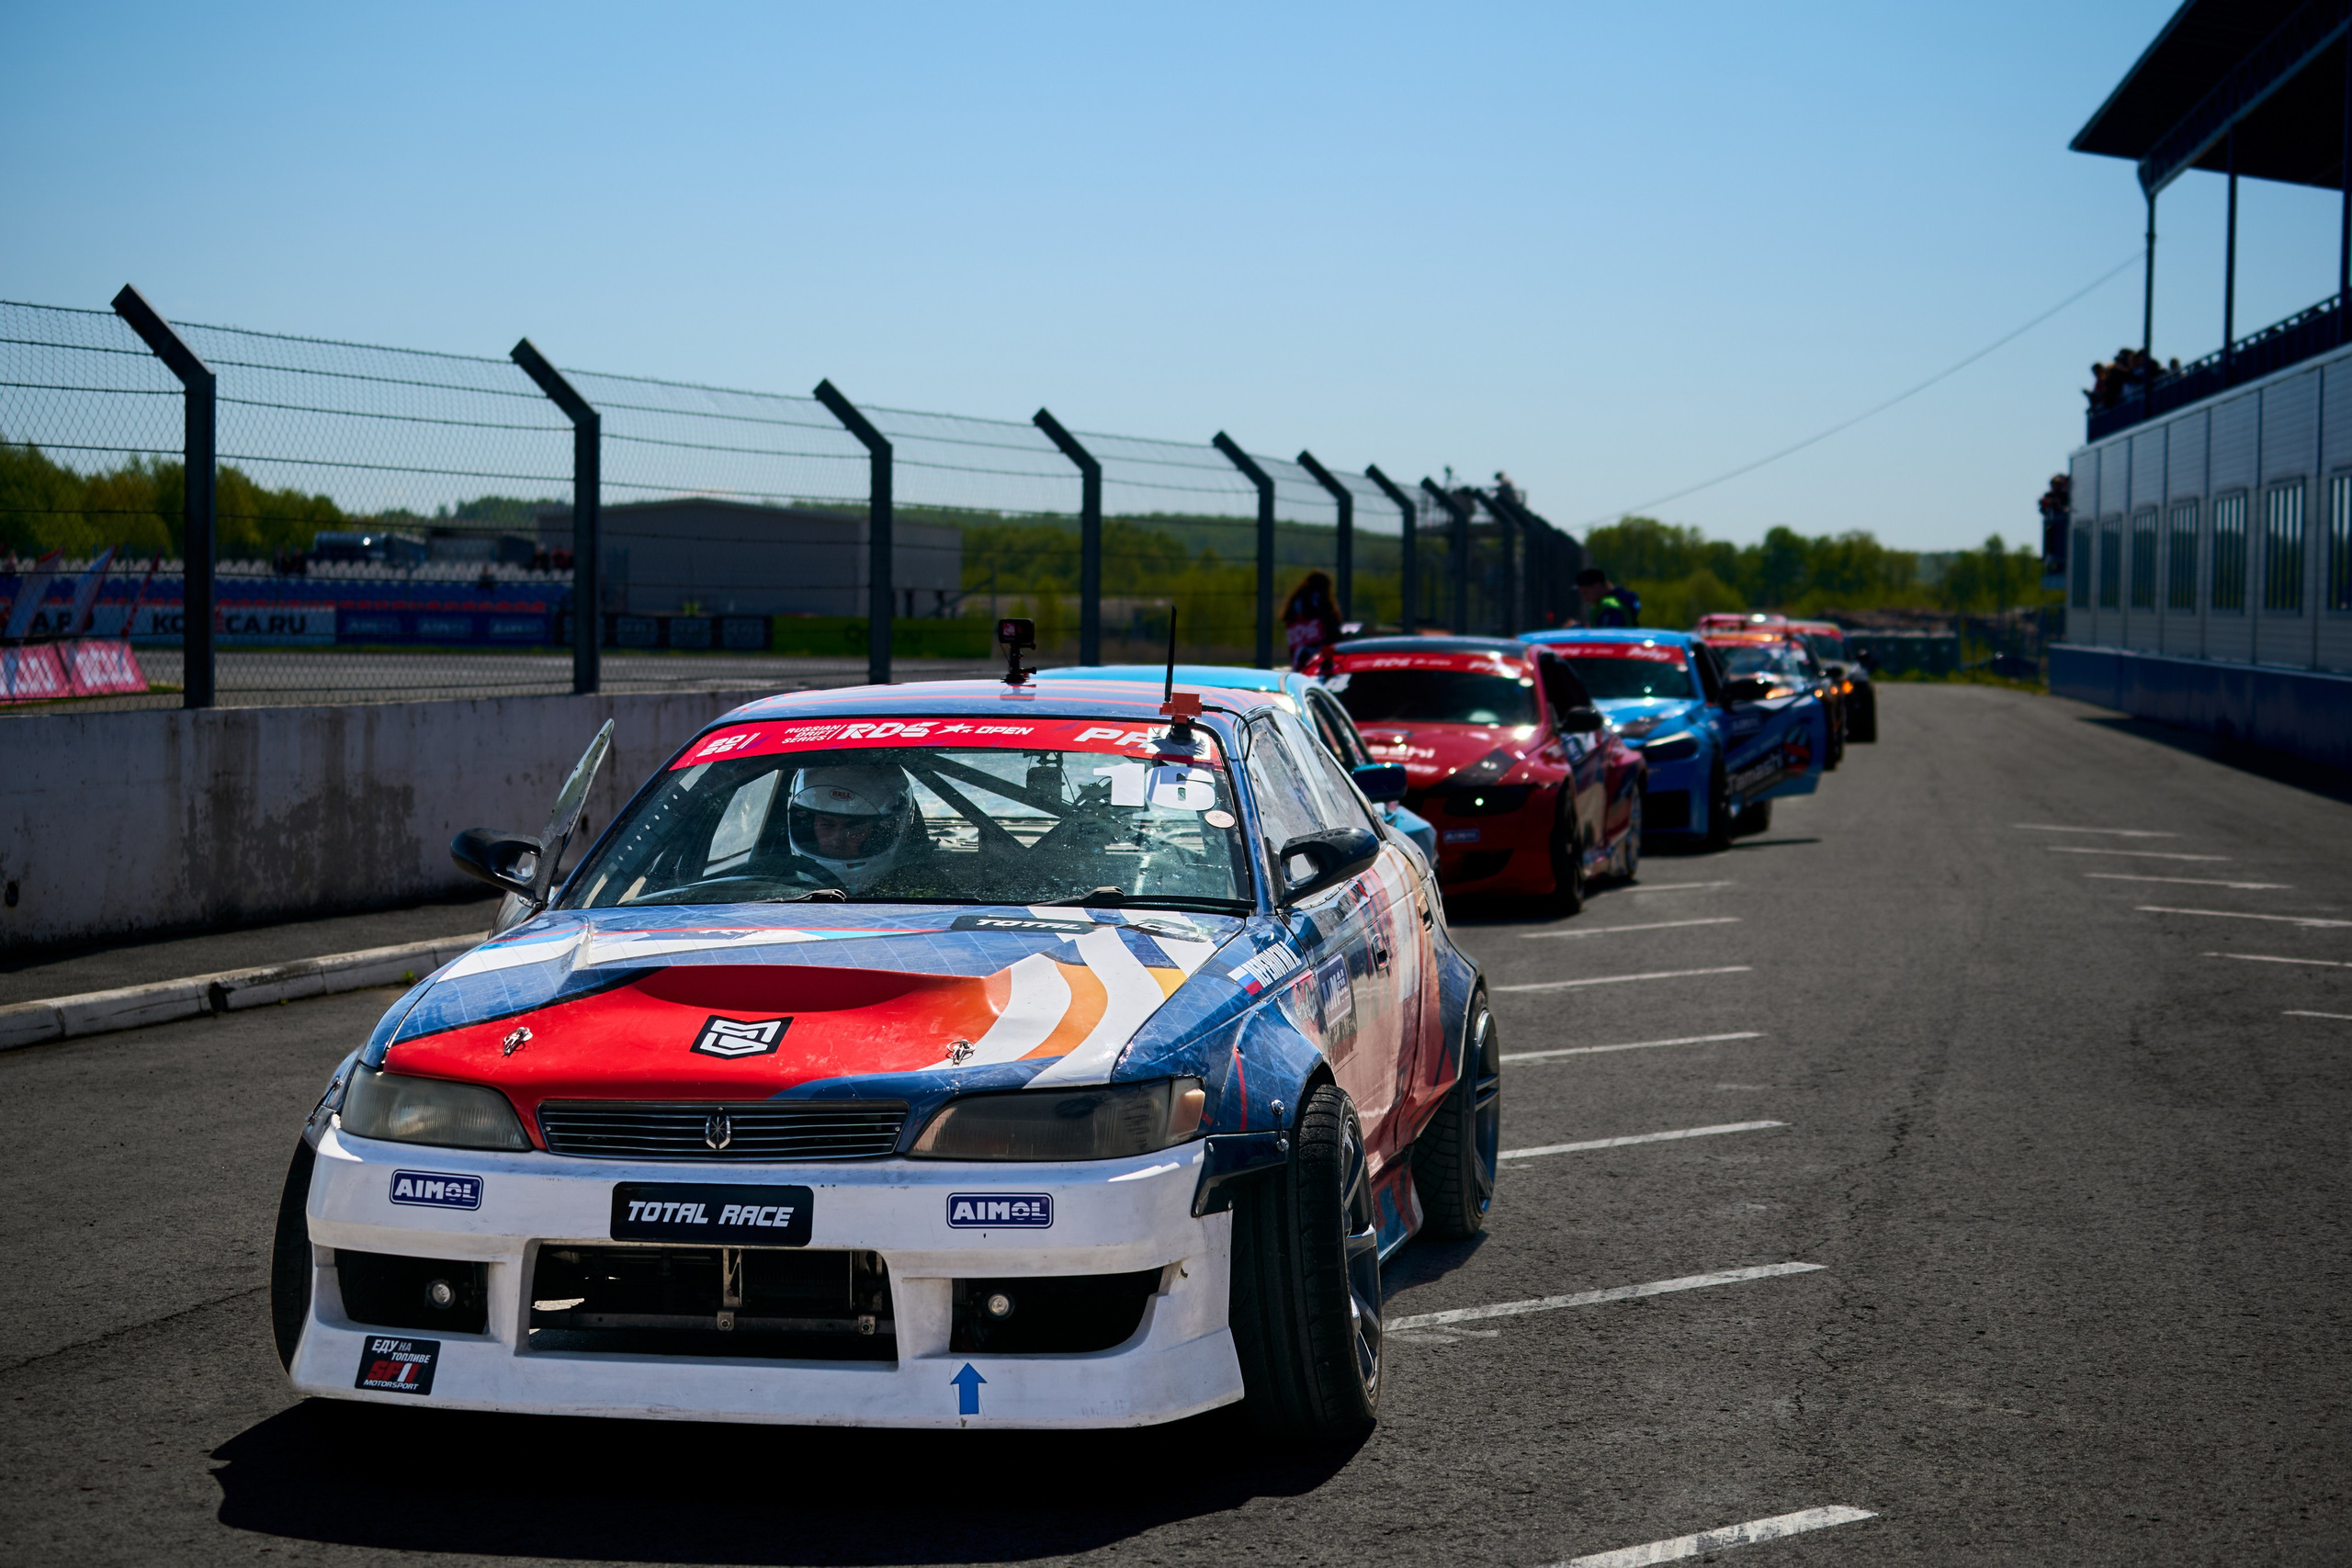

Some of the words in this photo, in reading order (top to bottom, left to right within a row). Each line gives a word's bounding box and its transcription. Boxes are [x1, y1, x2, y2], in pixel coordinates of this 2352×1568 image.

[785, 724, 842, 734] RUSSIAN
[836, 722, 941, 739] RDS
[974, 726, 1035, 735] OPEN
[781, 735, 827, 744] SERIES
[1093, 762, 1216, 810] 16
[832, 791, 852, 799] BELL
[976, 919, 1081, 930] TOTAL
[394, 1179, 476, 1202] AIMOL
[628, 1201, 708, 1224] TOTAL
[718, 1203, 795, 1227] RACE
[952, 1201, 1046, 1220] AIMOL
[371, 1339, 399, 1353] ЕДУ
[398, 1342, 412, 1351] НА
[391, 1352, 431, 1363] ТОПЛИВЕ
[364, 1379, 419, 1390] MOTORSPORT
